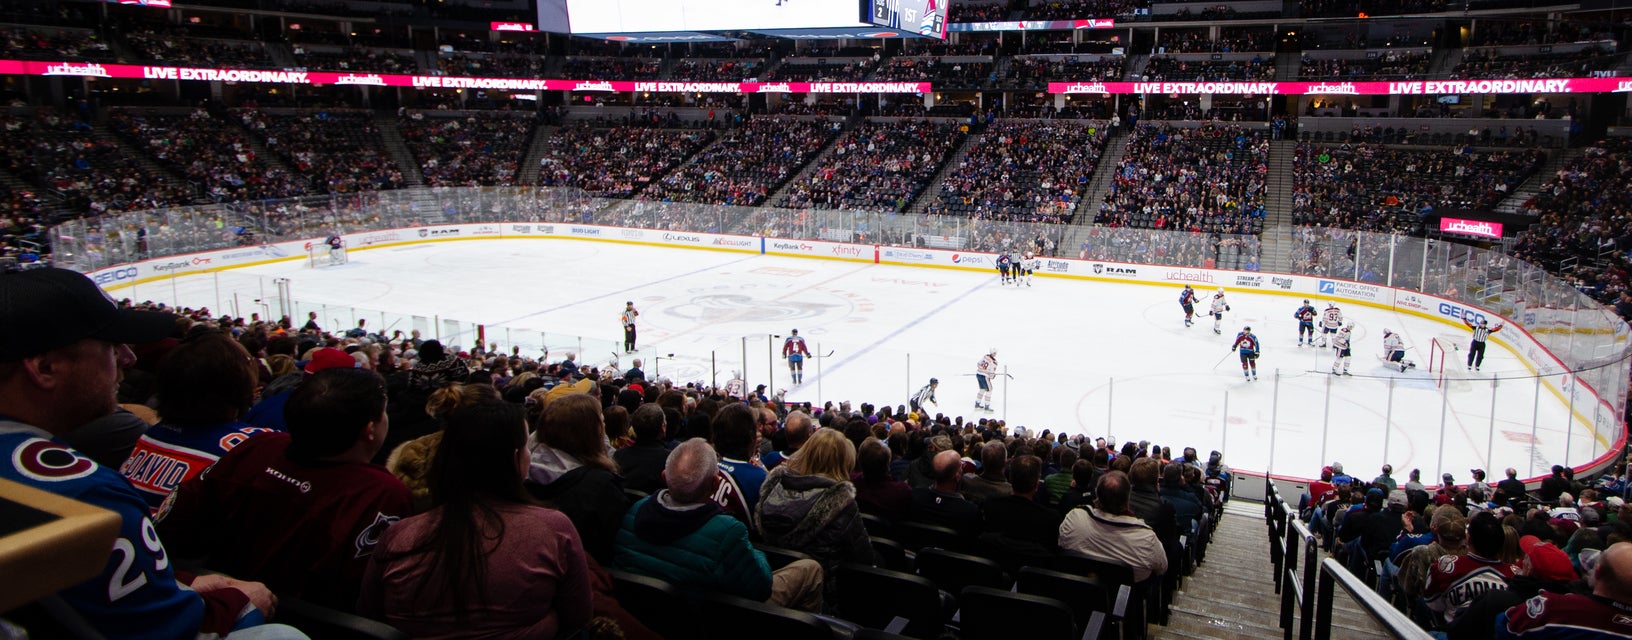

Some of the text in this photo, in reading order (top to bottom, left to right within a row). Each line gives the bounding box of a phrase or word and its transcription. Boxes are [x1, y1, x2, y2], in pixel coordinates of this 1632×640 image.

[877, 7, 883, 17] 2
[904, 8, 917, 23] 1ST
[47, 62, 920, 93] uchealth LIVE EXTRAORDINARY. uchealth LIVE EXTRAORDINARY. uchealth LIVE EXTRAORDINARY. uchealth LIVE EXTRAORDINARY.
[1066, 82, 1106, 93] uchealth
[1134, 82, 1160, 94] LIVE
[1163, 82, 1279, 94] EXTRAORDINARY.
[1308, 82, 1356, 93] uchealth
[1389, 82, 1423, 94] LIVE
[1425, 80, 1571, 94] EXTRAORDINARY.
[1448, 220, 1493, 234] uchealth
[773, 242, 799, 250] KeyBank
[832, 245, 862, 256] xfinity
[153, 260, 190, 271] KeyBank
[962, 255, 983, 265] pepsi
[94, 267, 138, 286] GEICO
[1167, 268, 1214, 283] uchealth
[1335, 281, 1380, 293] PACIFIC OFFICE
[1335, 288, 1376, 298] AUTOMATION
[1328, 313, 1338, 322] 93
[1438, 302, 1486, 326] GEICO
[792, 342, 799, 353] 4
[108, 515, 168, 603] 29
